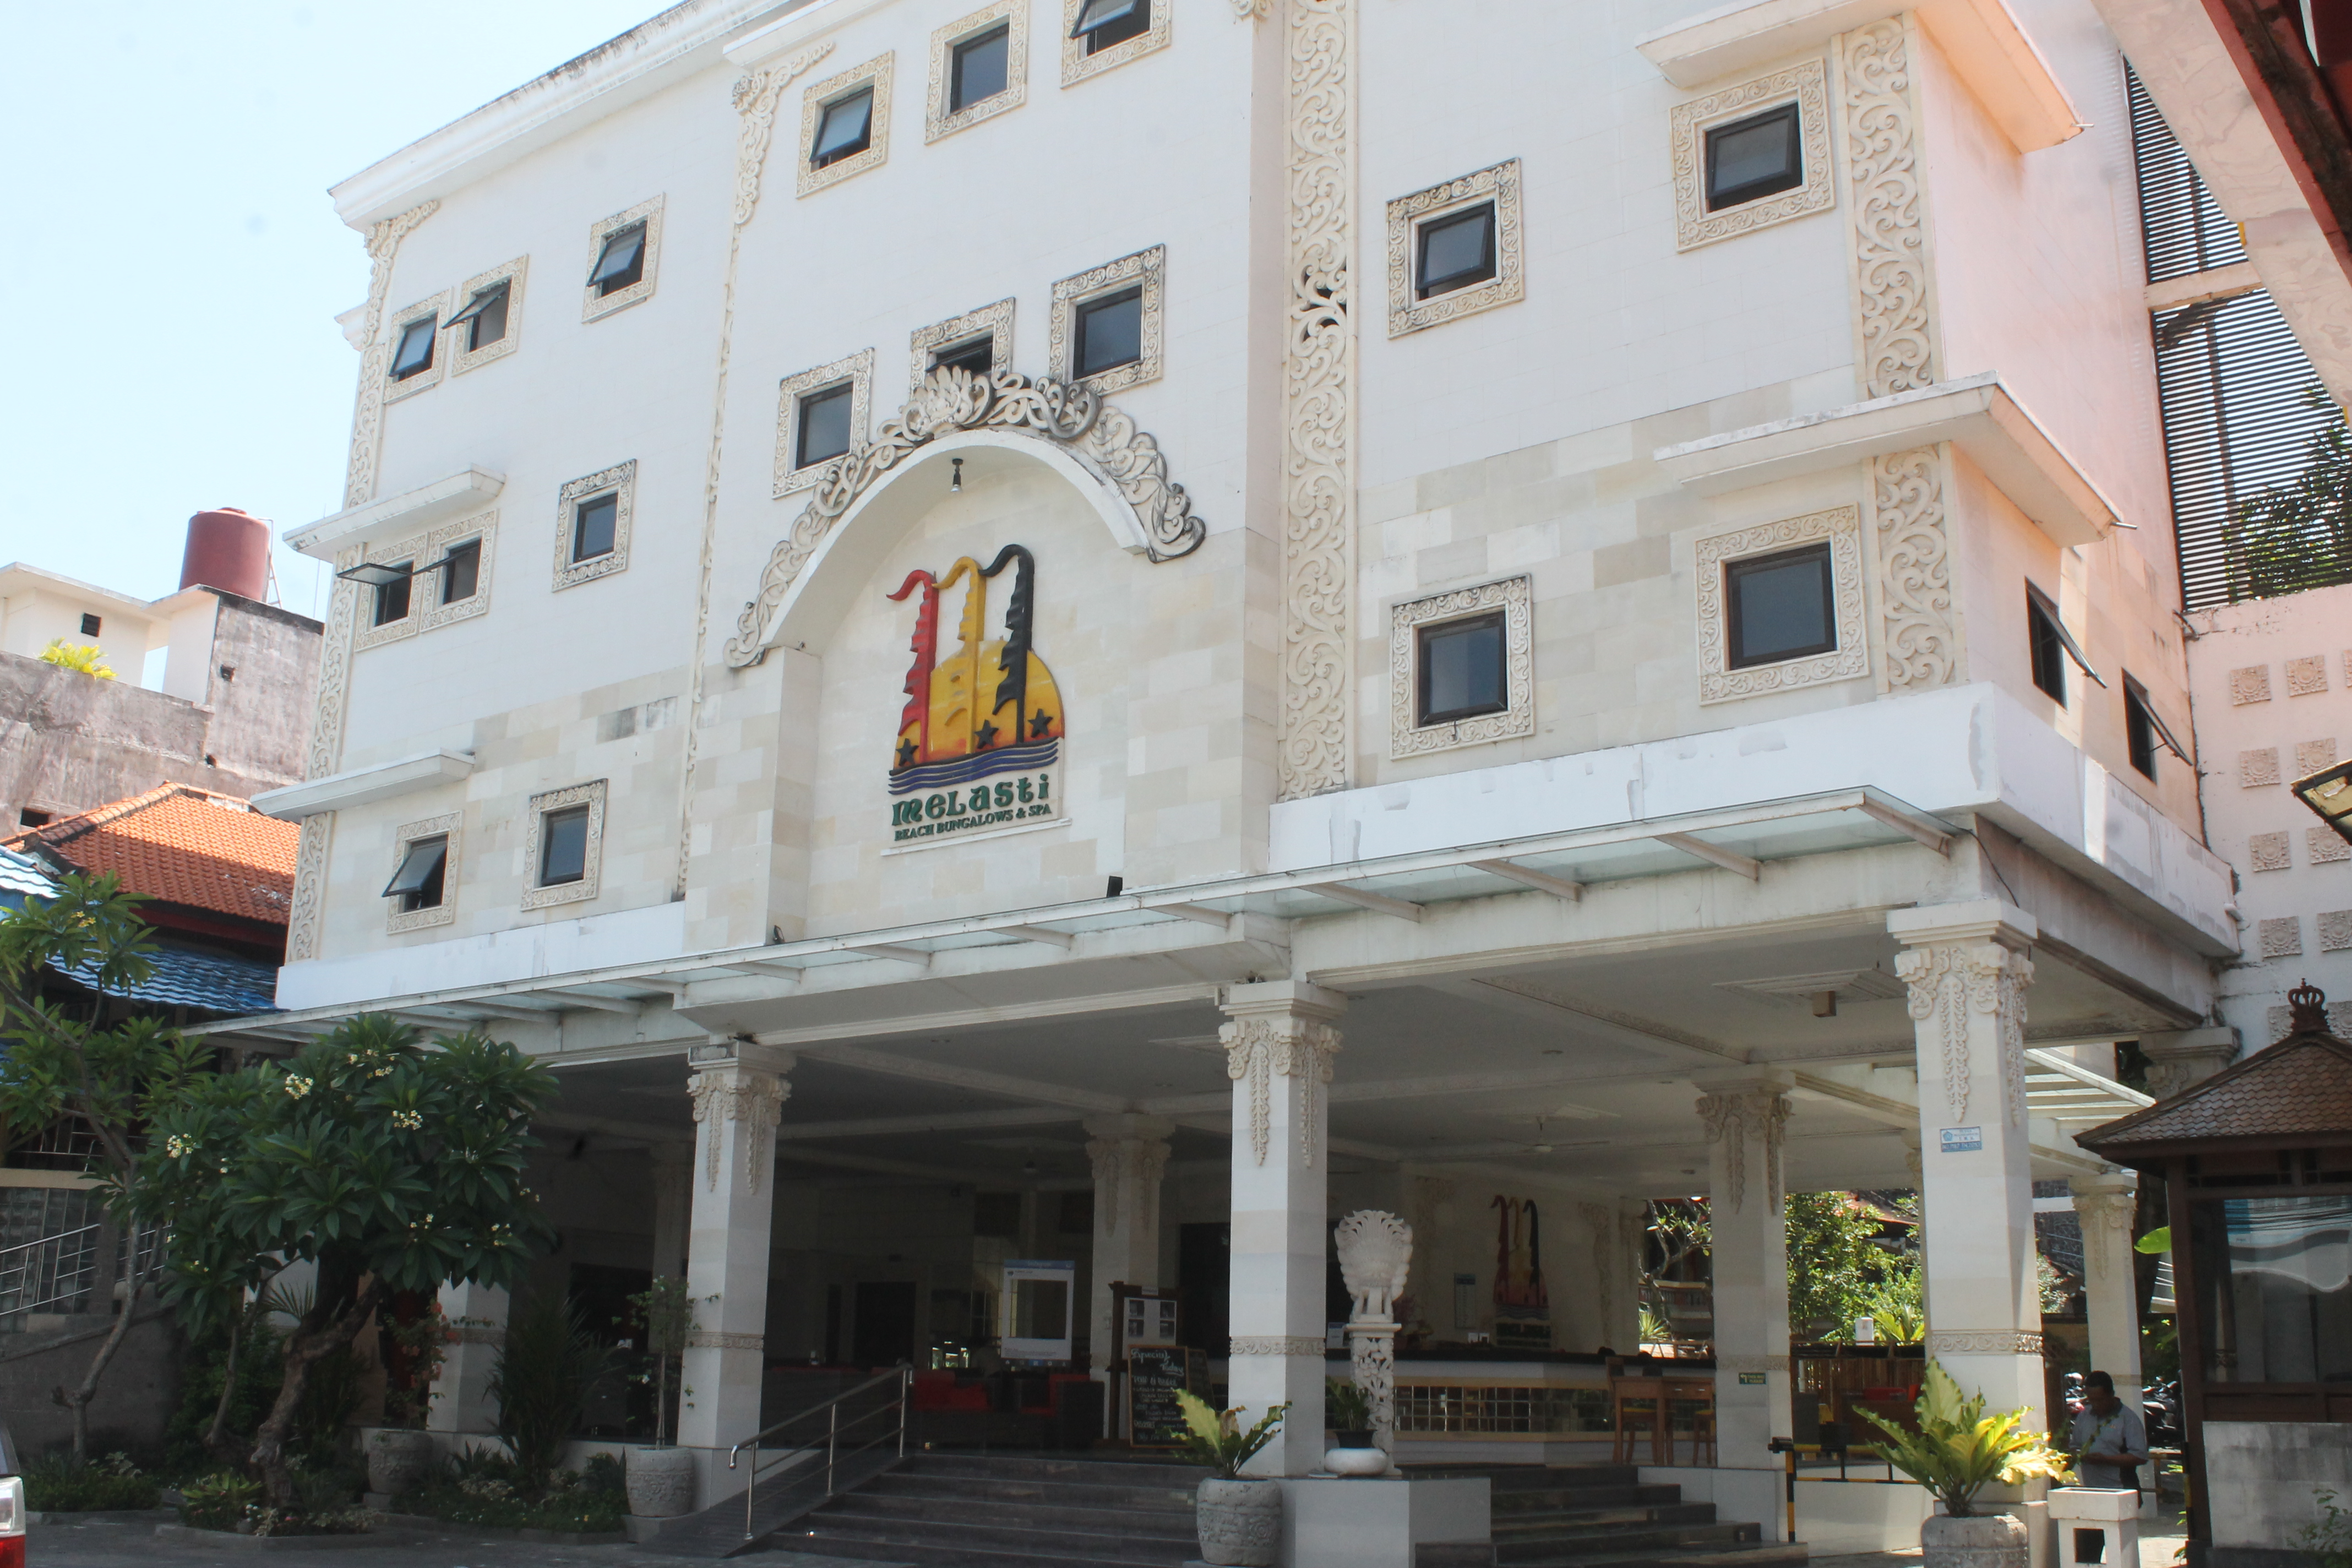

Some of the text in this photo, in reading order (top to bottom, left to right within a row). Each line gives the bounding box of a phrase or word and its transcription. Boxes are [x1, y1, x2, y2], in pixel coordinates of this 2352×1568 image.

[894, 803, 1053, 841] BEACH BUNGALOWS & SPA
